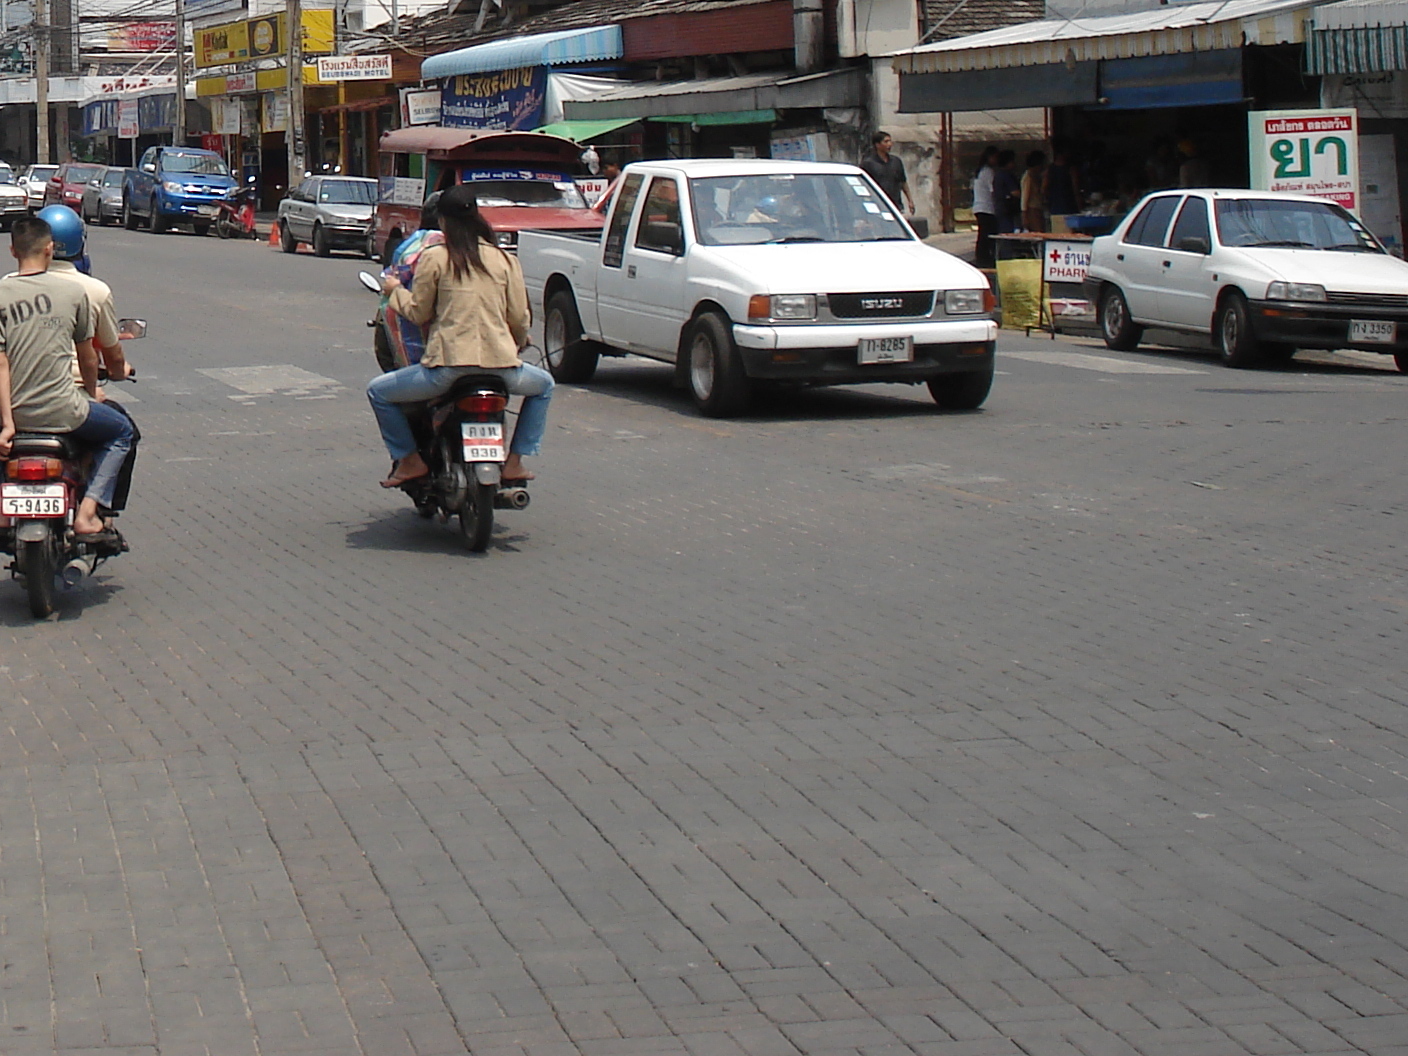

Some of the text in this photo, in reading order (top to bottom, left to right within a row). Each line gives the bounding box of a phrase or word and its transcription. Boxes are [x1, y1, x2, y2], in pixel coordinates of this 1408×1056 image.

[365, 69, 390, 77] MOTEL
[1270, 136, 1347, 179] ยา
[861, 298, 903, 310] ISUZU
[471, 447, 498, 458] 938
